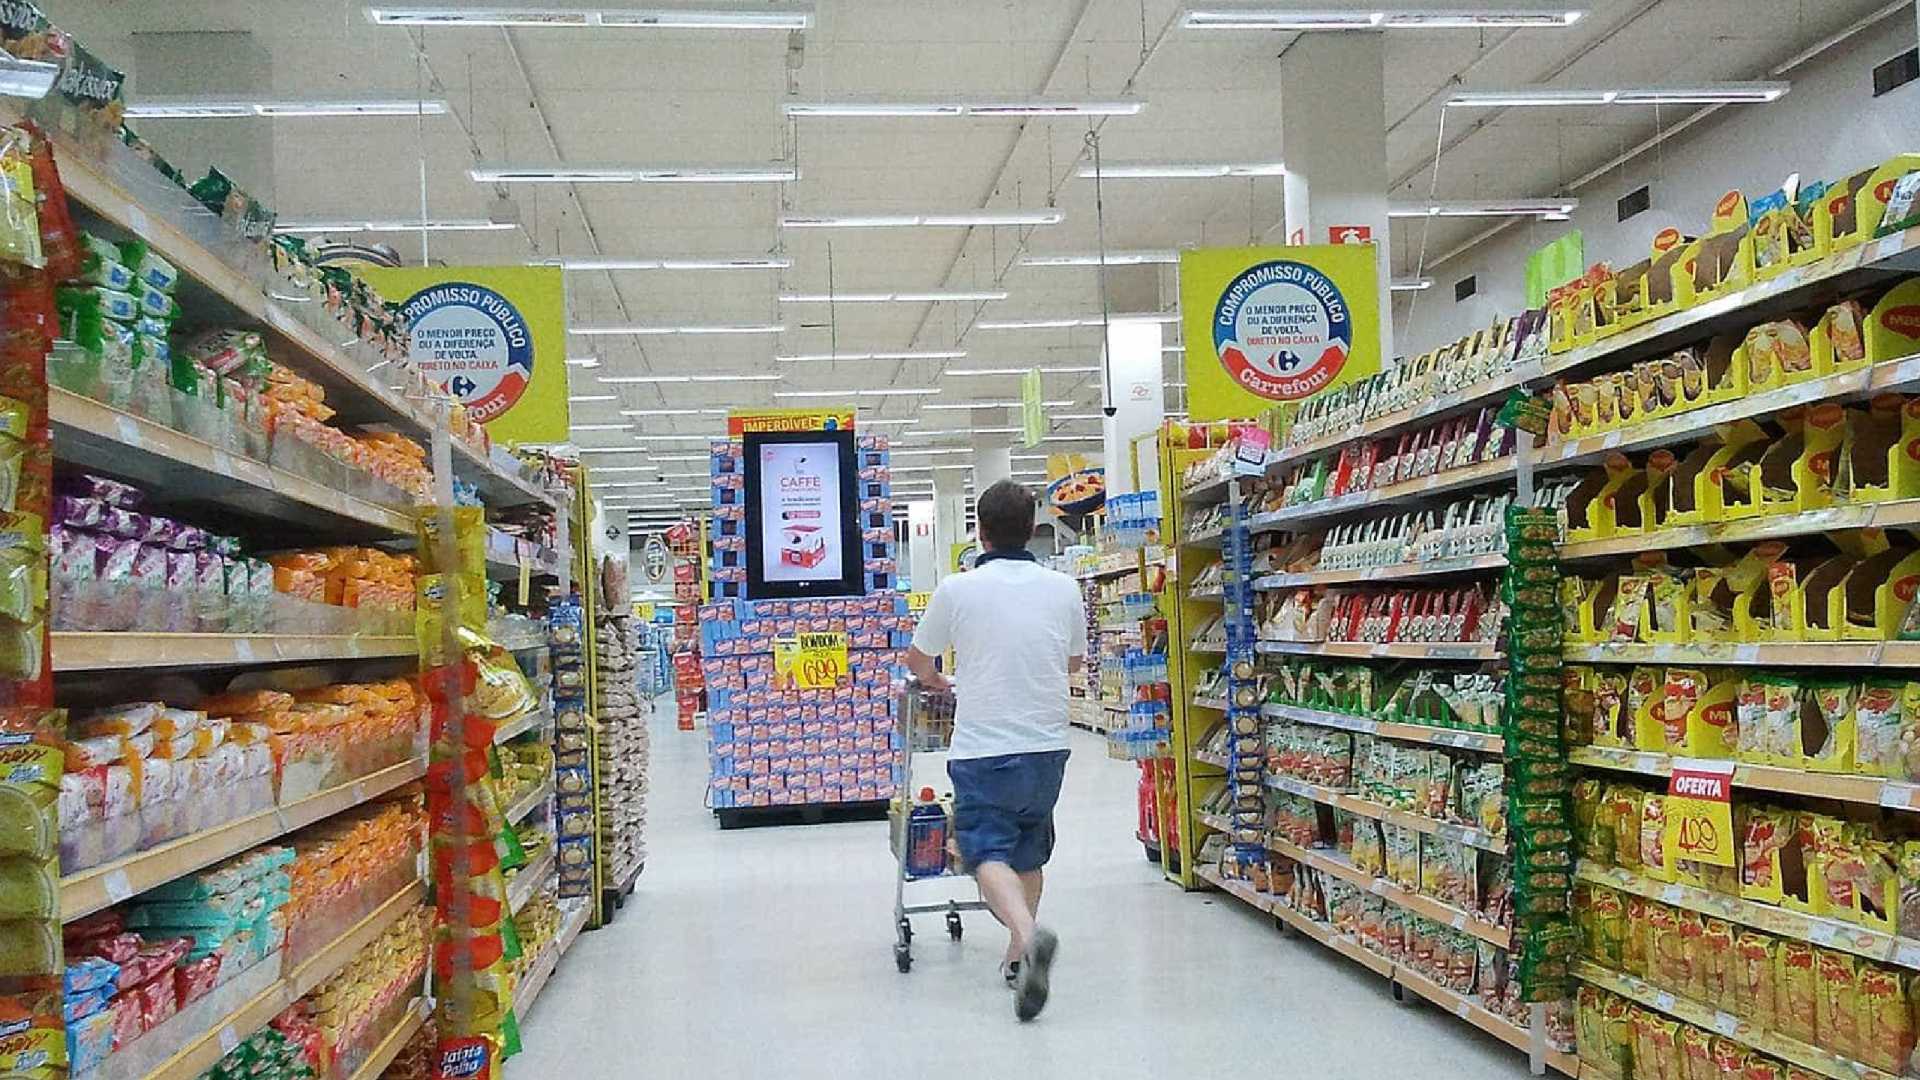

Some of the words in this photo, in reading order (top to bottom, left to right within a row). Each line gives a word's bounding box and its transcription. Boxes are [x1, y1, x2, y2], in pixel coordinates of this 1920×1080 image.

[1218, 266, 1302, 326] COMPROMISSO
[1304, 272, 1345, 323] PÚBLICO
[1246, 306, 1253, 315] O
[1254, 305, 1287, 315] MENOR
[405, 288, 479, 320] PROMISSO
[481, 294, 526, 349] PÚBLICO
[1247, 316, 1260, 326] OU
[1262, 316, 1269, 325] A
[1270, 314, 1318, 326] DIFERENÇA
[417, 329, 425, 339] O
[427, 328, 463, 339] MENOR
[1261, 326, 1272, 335] DE
[418, 340, 432, 349] OU
[434, 340, 442, 349] A
[443, 339, 495, 349] DIFERENÇA
[1293, 335, 1320, 345] CAIXA
[435, 350, 447, 360] DE
[468, 360, 498, 370] CAIXA
[1240, 366, 1329, 395] Carrefour
[1675, 776, 1723, 798] OFERTA
